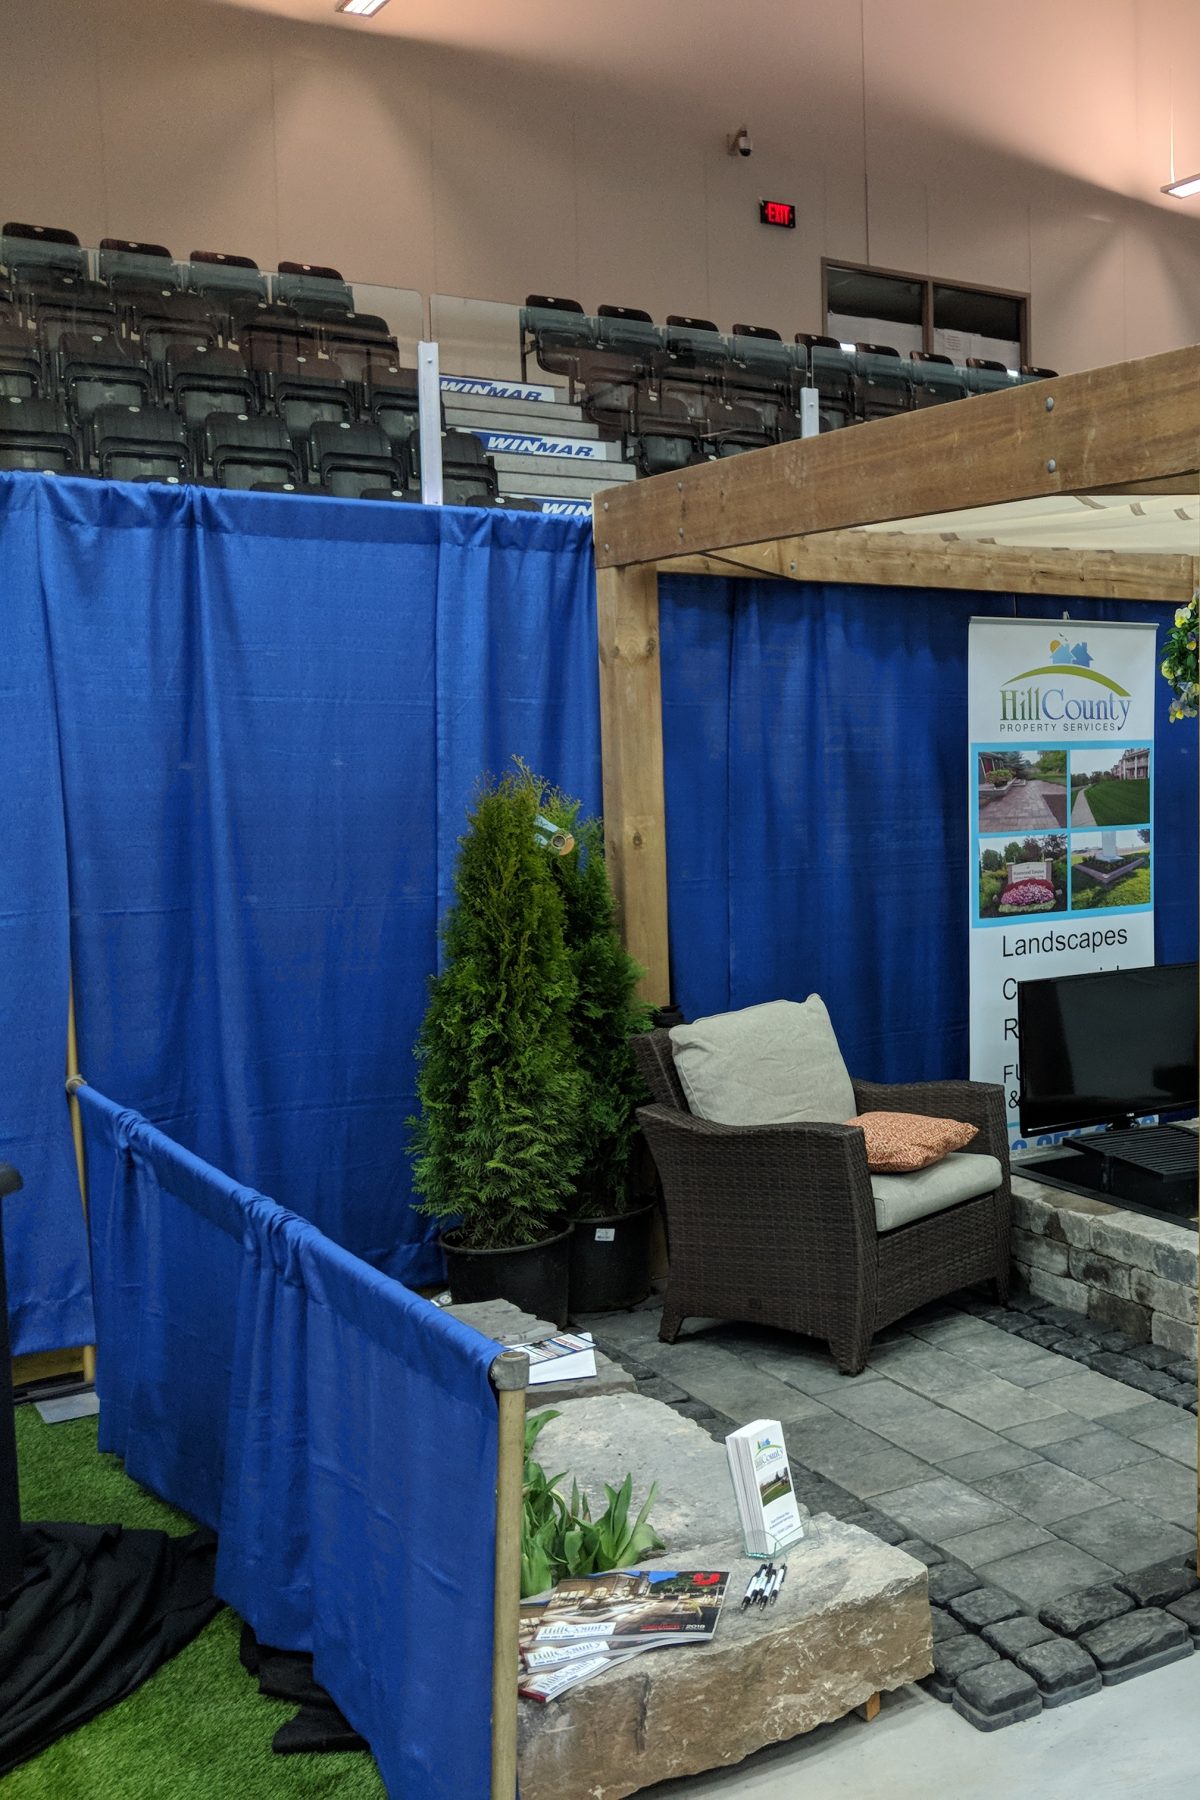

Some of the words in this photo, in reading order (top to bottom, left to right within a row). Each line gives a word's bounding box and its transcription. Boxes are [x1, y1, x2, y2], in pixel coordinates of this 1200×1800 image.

[768, 203, 789, 225] EXIT
[440, 380, 542, 402] WINMAR
[487, 437, 593, 456] WINMAR
[542, 502, 593, 517] WIN
[1000, 687, 1131, 731] HillCounty
[1000, 723, 1057, 733] PROPERTY
[1063, 722, 1115, 732] SERVICES
[1003, 928, 1128, 957] Landscapes
